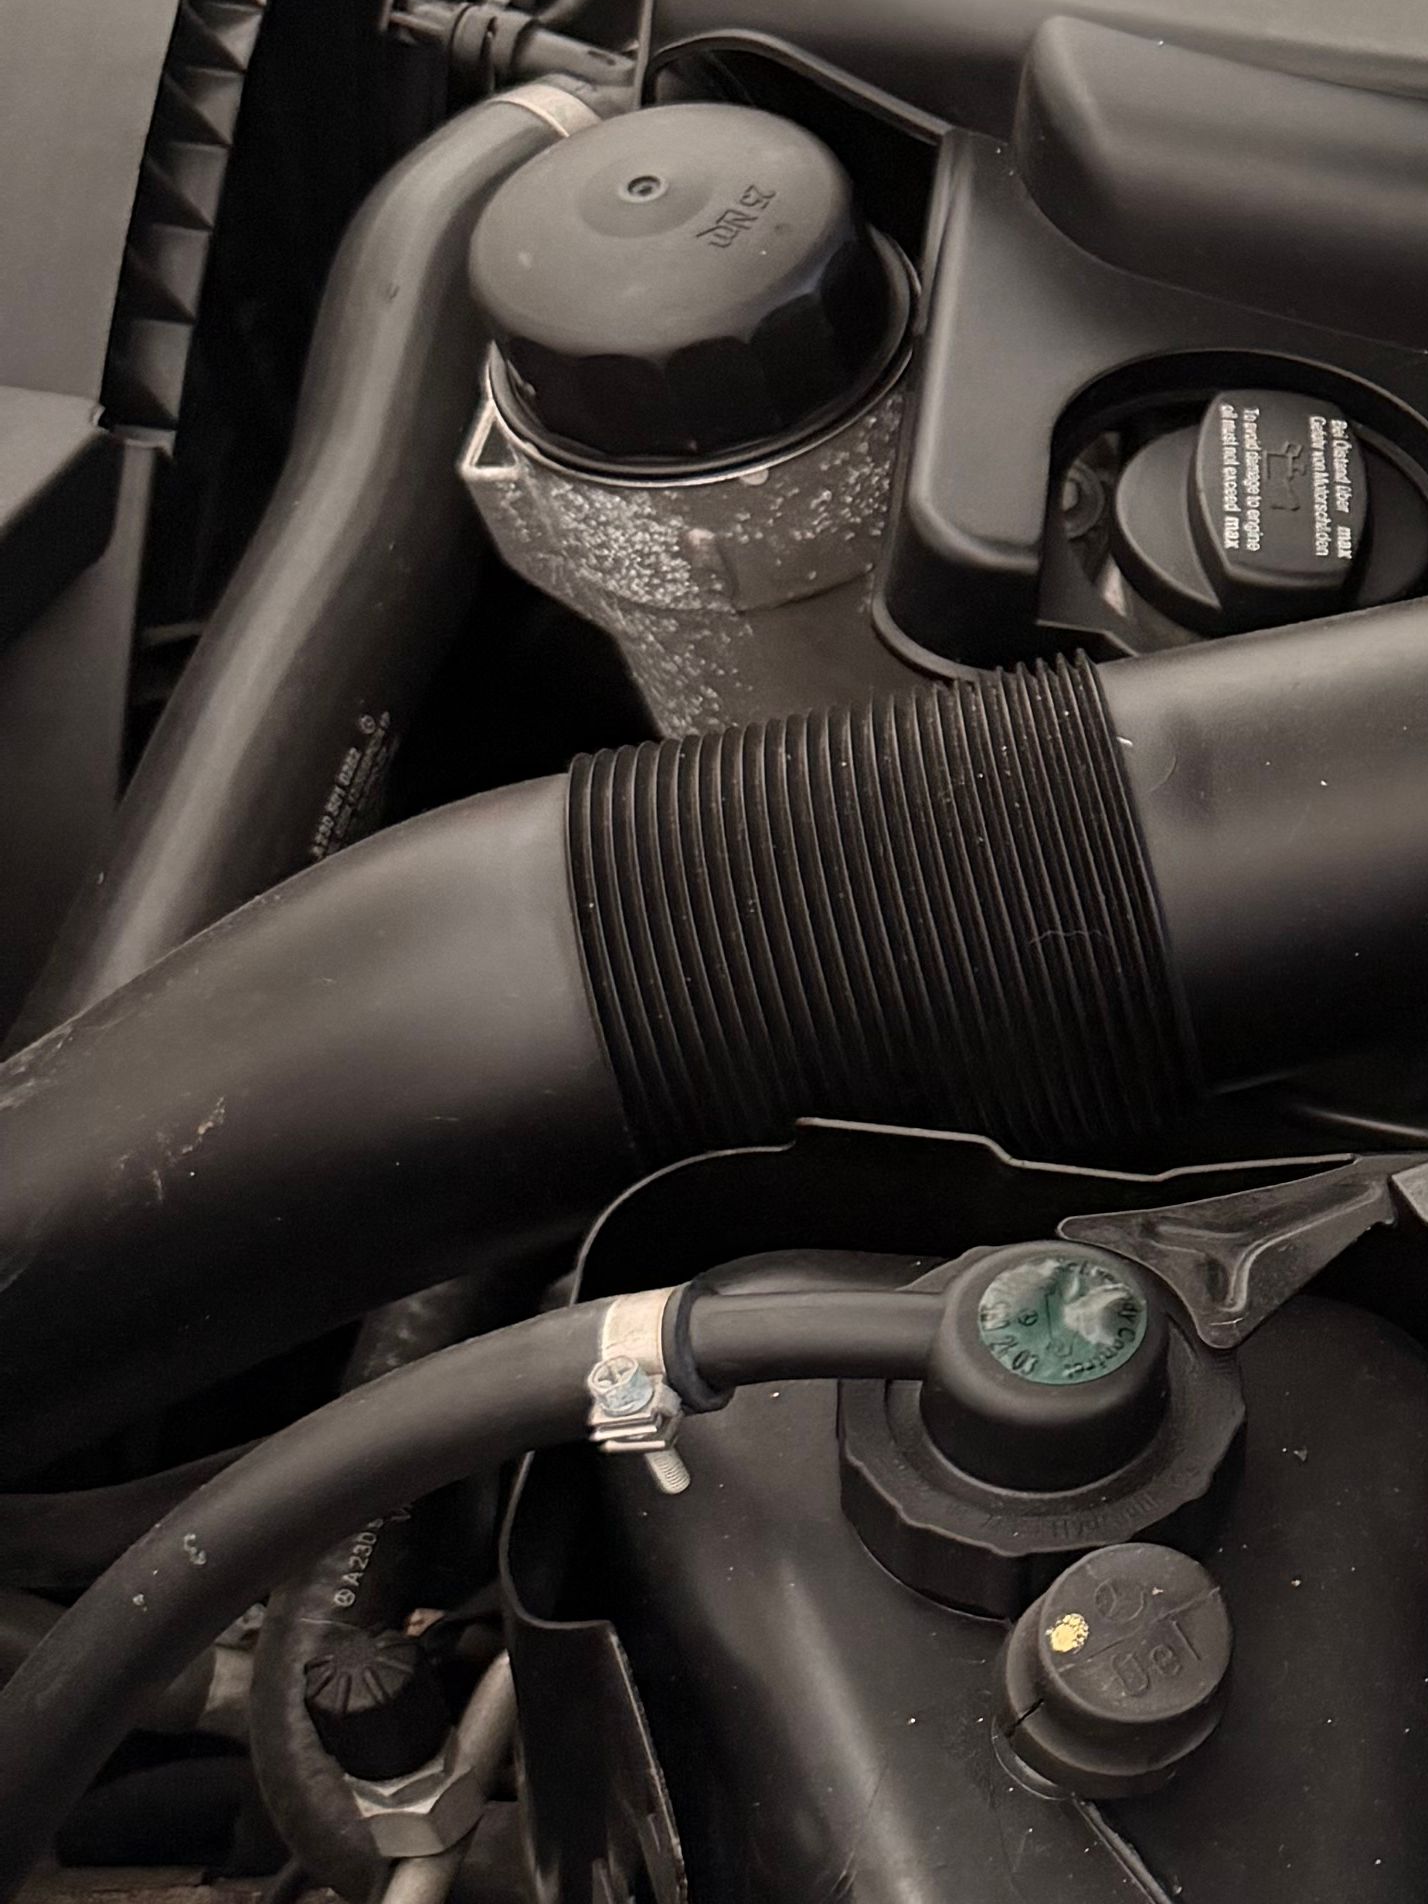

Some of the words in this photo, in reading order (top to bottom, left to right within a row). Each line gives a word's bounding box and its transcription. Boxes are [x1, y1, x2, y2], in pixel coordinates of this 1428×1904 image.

[740, 184, 777, 209] 25
[1220, 404, 1238, 419] oil
[1243, 408, 1260, 422] To
[1221, 419, 1239, 446] must
[1244, 422, 1262, 451] avoid
[1331, 419, 1349, 438] Bei
[1223, 446, 1241, 466] not
[1243, 451, 1261, 495] damage
[1223, 467, 1241, 512] exceed
[1246, 496, 1262, 508] to
[1335, 485, 1352, 513] über
[1224, 515, 1240, 549] max
[1243, 509, 1264, 553] engine
[1337, 525, 1352, 559] max
